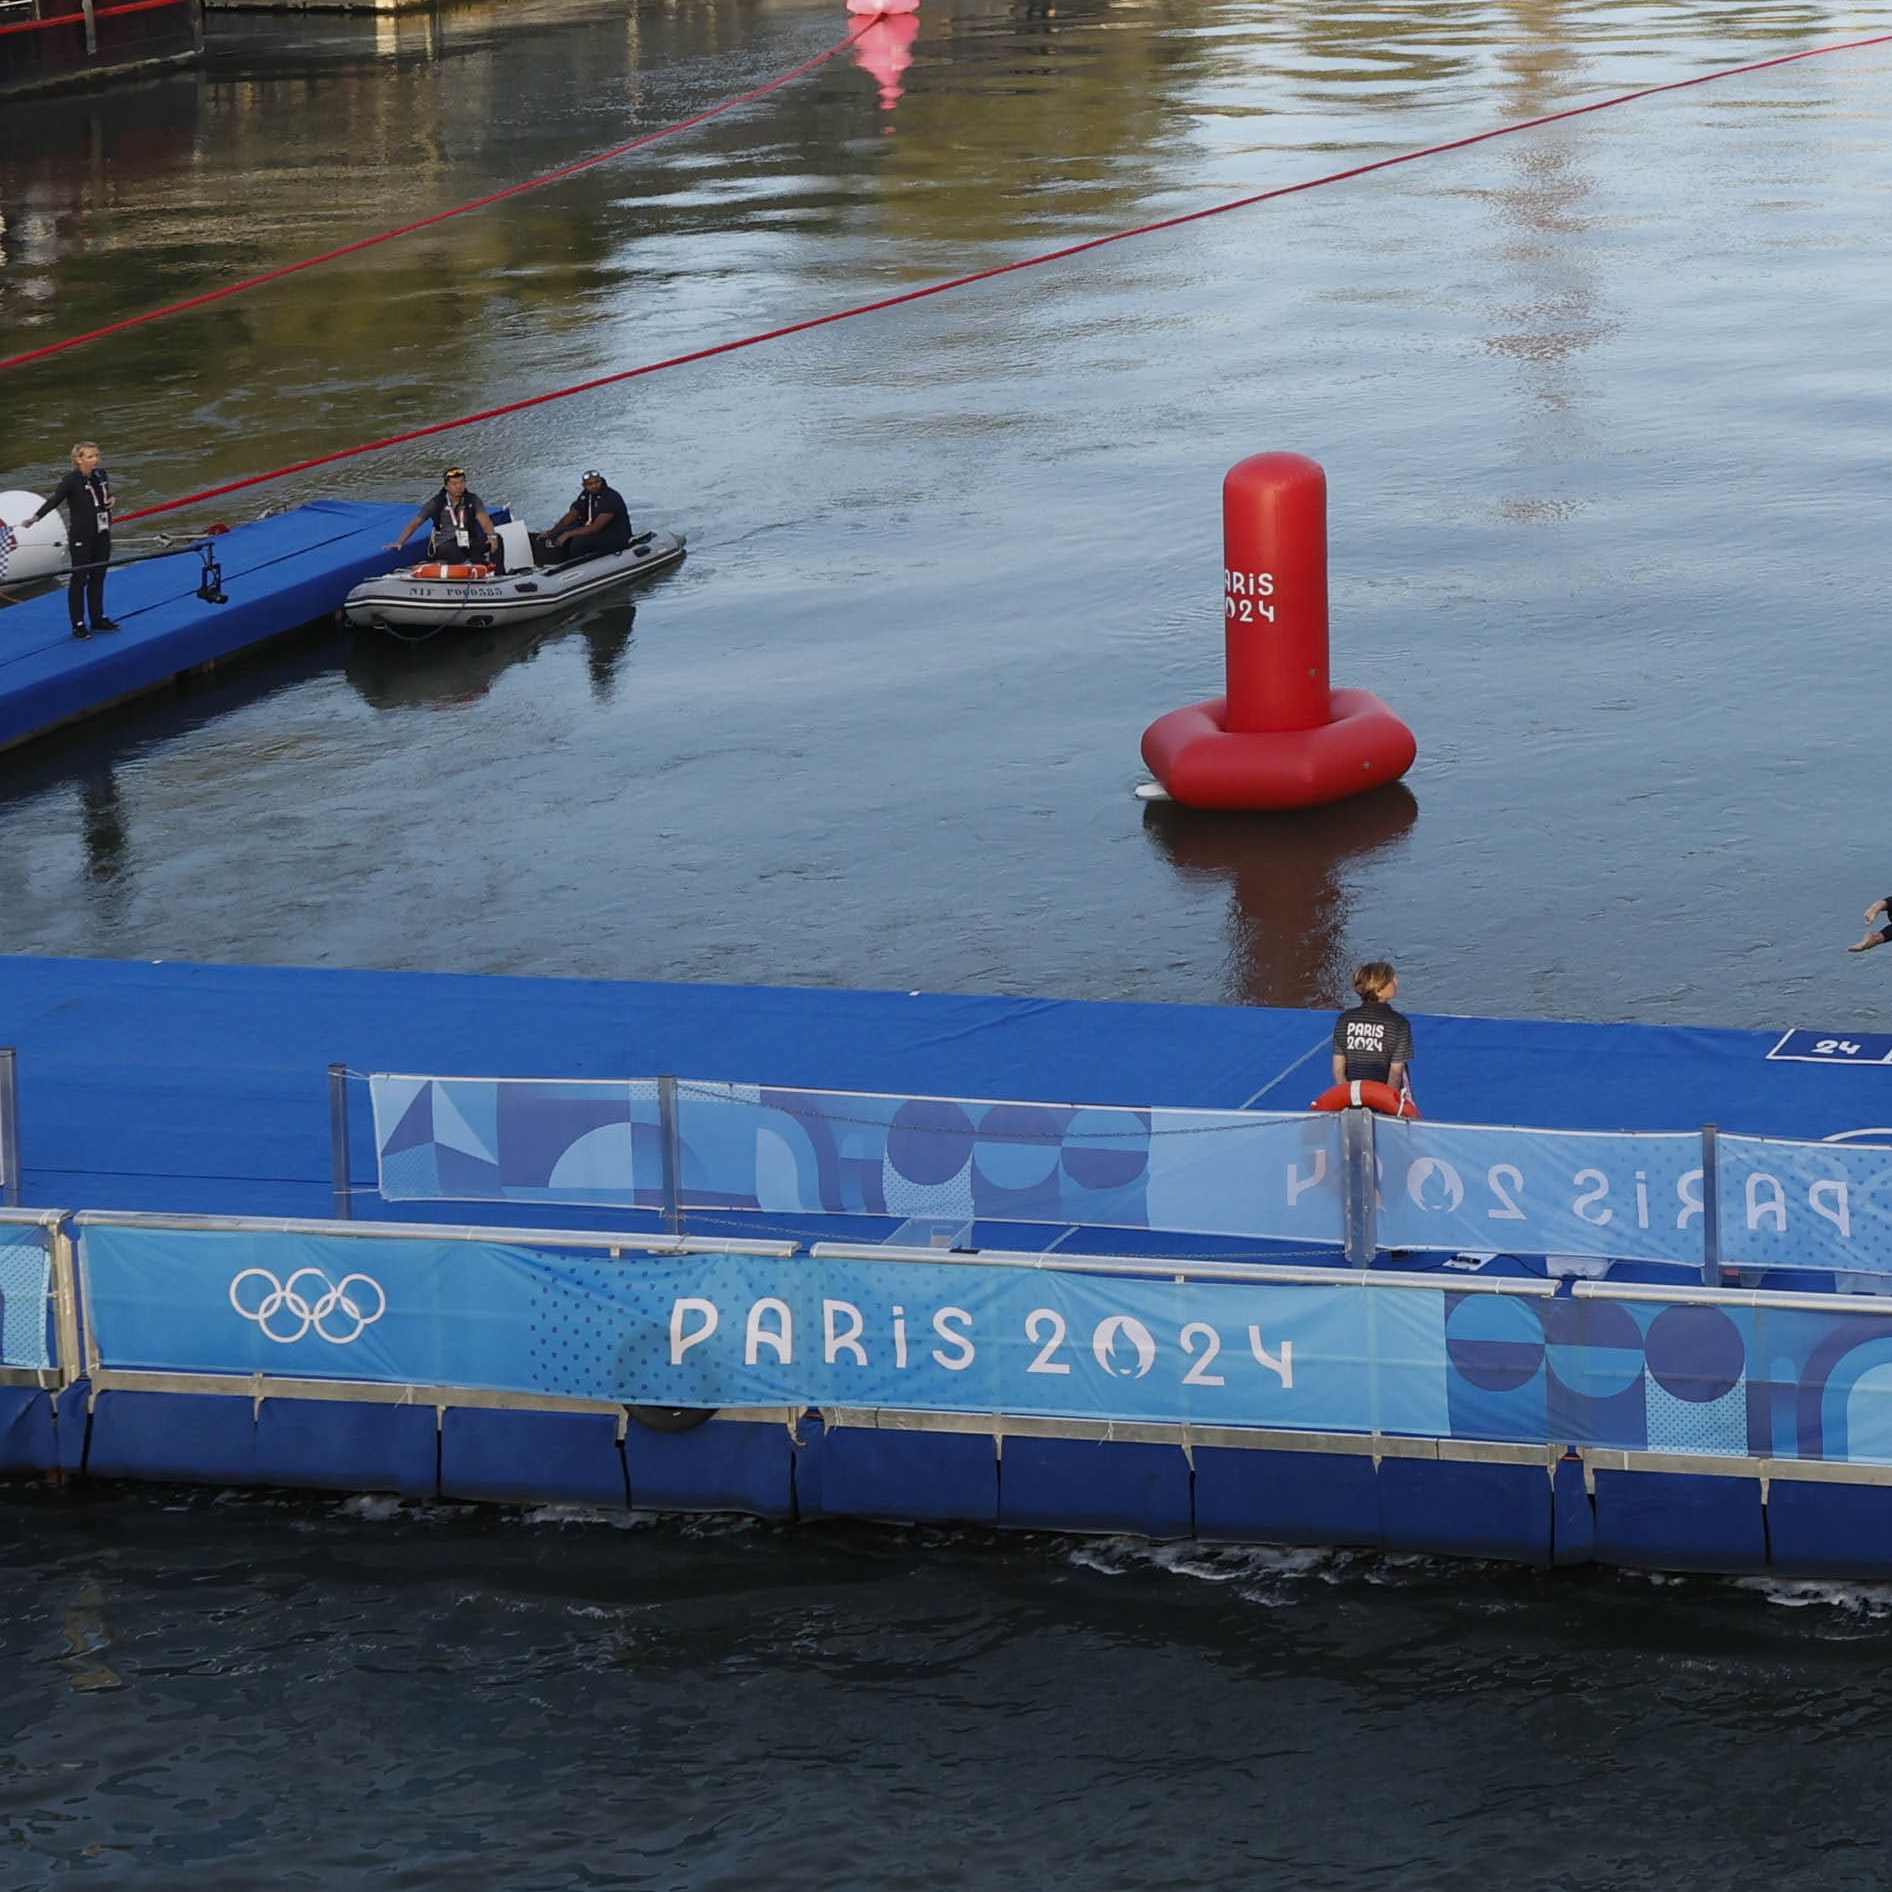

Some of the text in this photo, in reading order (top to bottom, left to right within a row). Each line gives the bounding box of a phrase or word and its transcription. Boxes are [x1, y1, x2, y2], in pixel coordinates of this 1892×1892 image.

[1224, 600, 1275, 623] 024
[1346, 1036, 1383, 1052] 2024
[1811, 1039, 1863, 1055] 24
[1024, 1308, 1293, 1389] 2024
